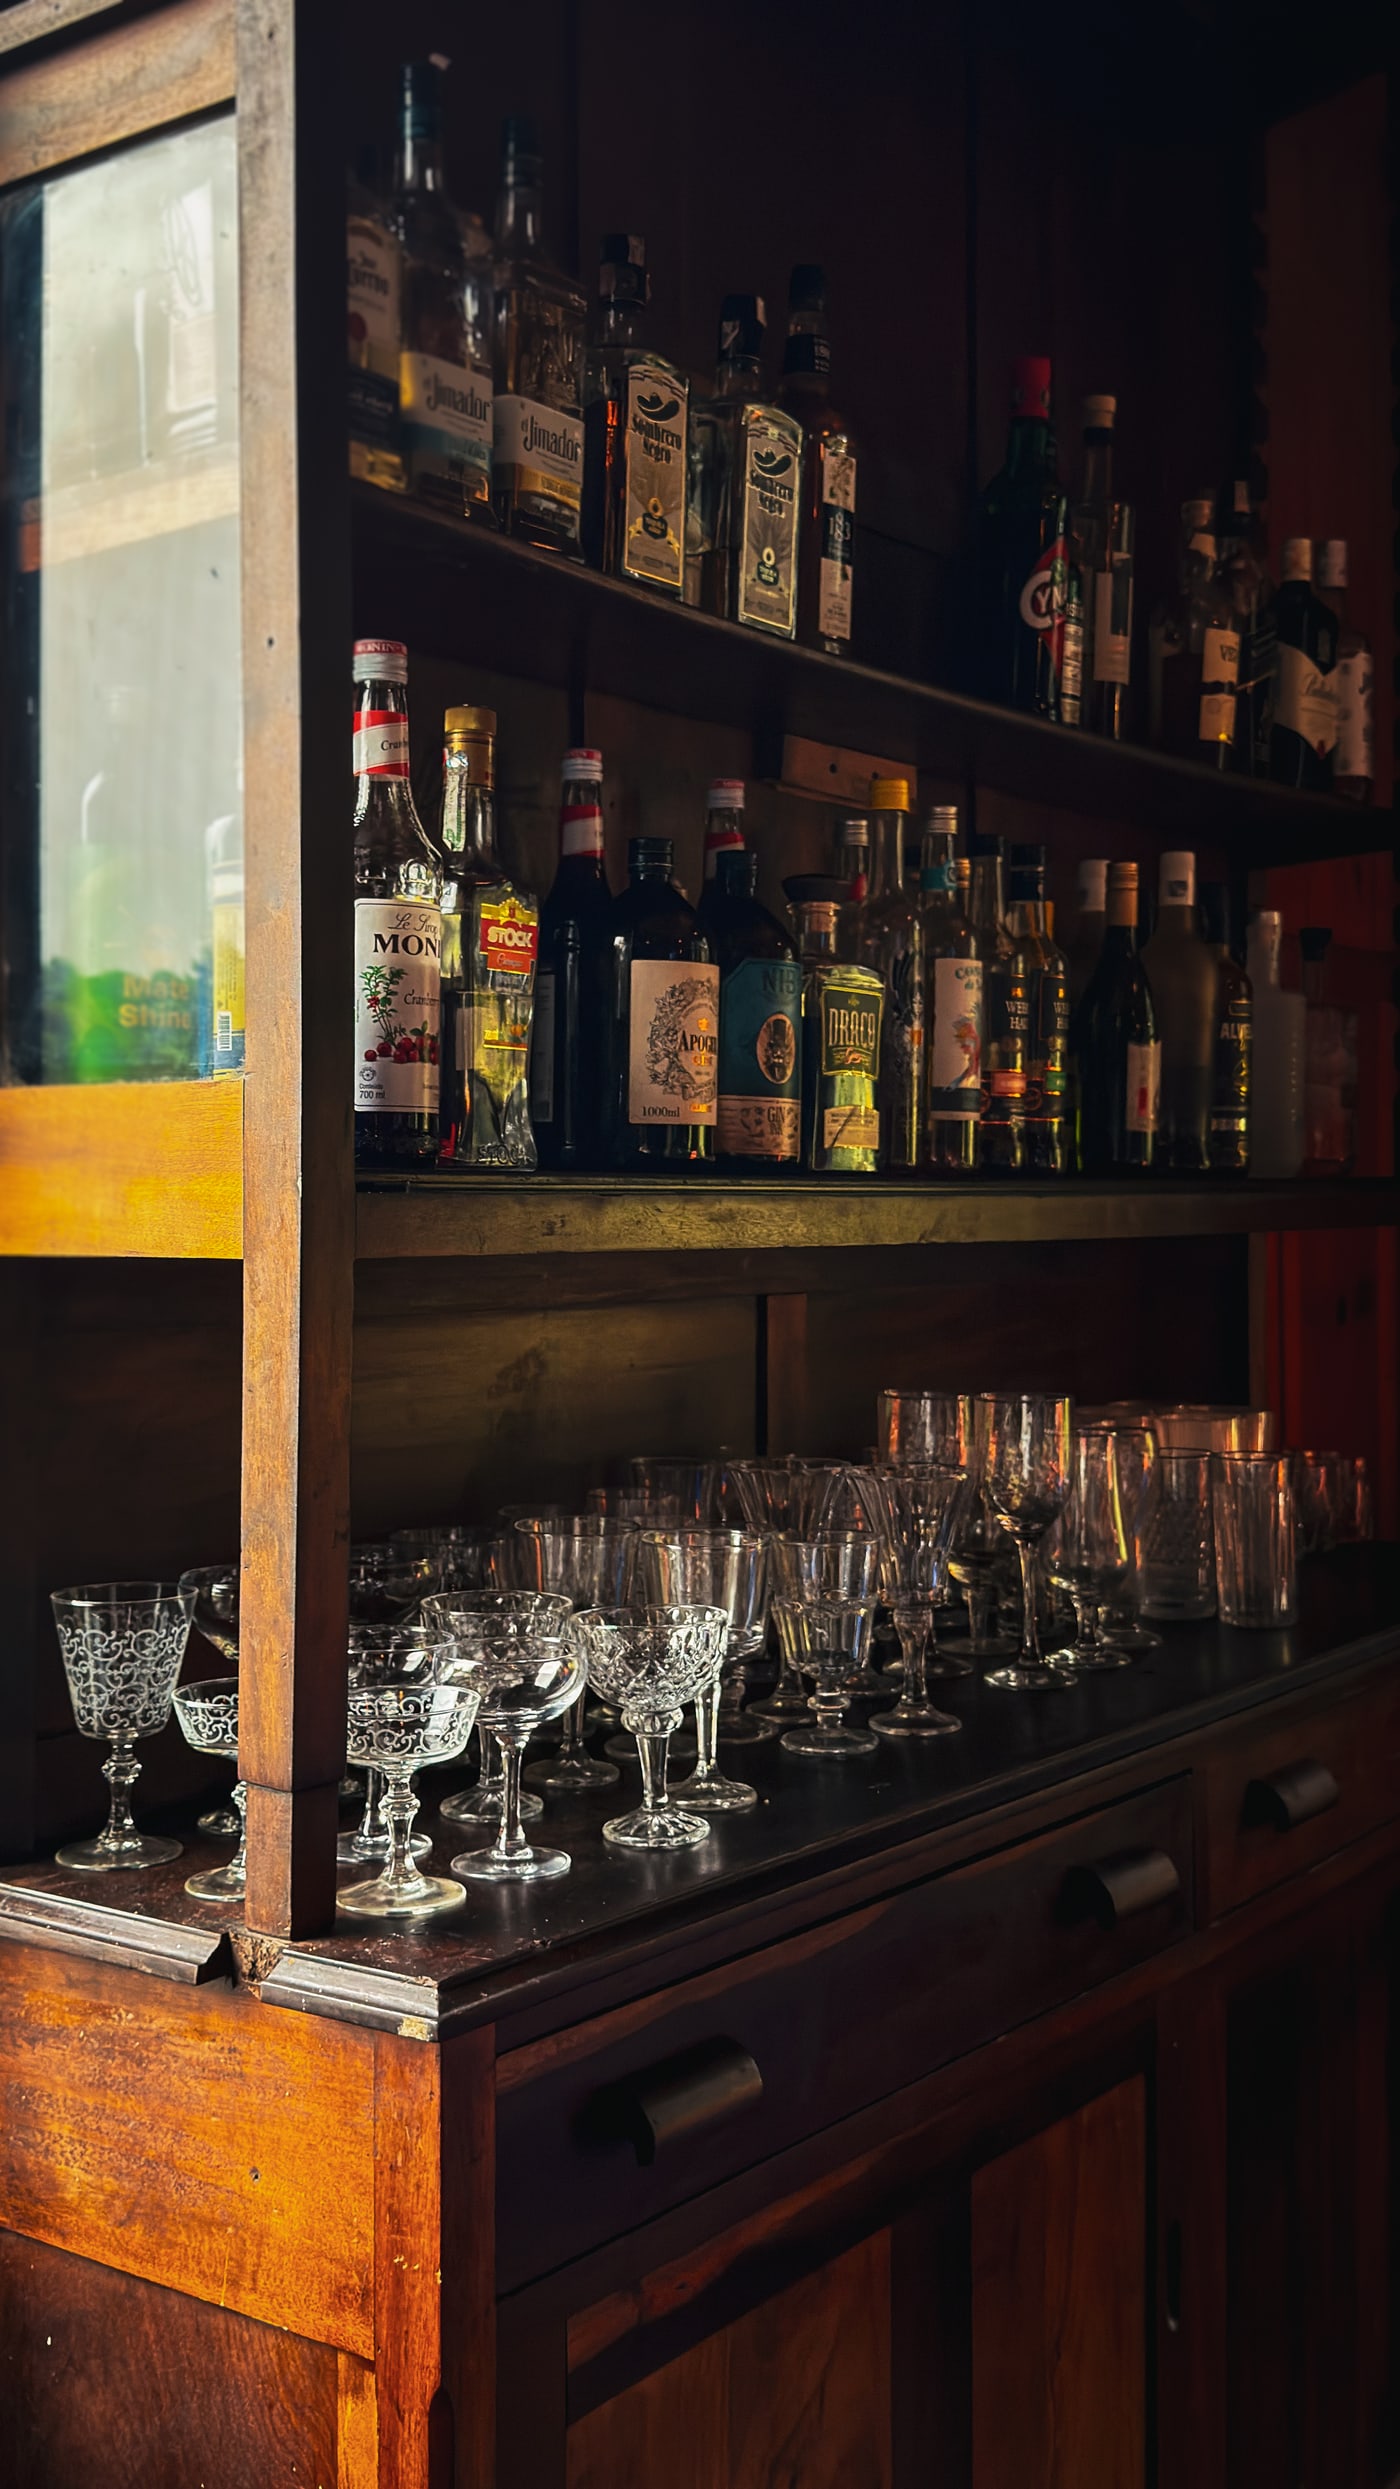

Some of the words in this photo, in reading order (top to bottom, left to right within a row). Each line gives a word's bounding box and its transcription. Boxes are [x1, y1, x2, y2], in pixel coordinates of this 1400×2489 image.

[426, 371, 491, 421] Jimador
[523, 415, 581, 462] Jimador
[632, 413, 682, 450] Sombrero
[642, 436, 671, 464] Negro
[387, 912, 412, 930] Le
[487, 925, 534, 948] STOCK
[828, 1007, 876, 1050] DRACO
[359, 1090, 374, 1099] 700
[376, 1090, 385, 1099] ml
[642, 1106, 680, 1118] 1000ml
[768, 1106, 786, 1123] GIN
